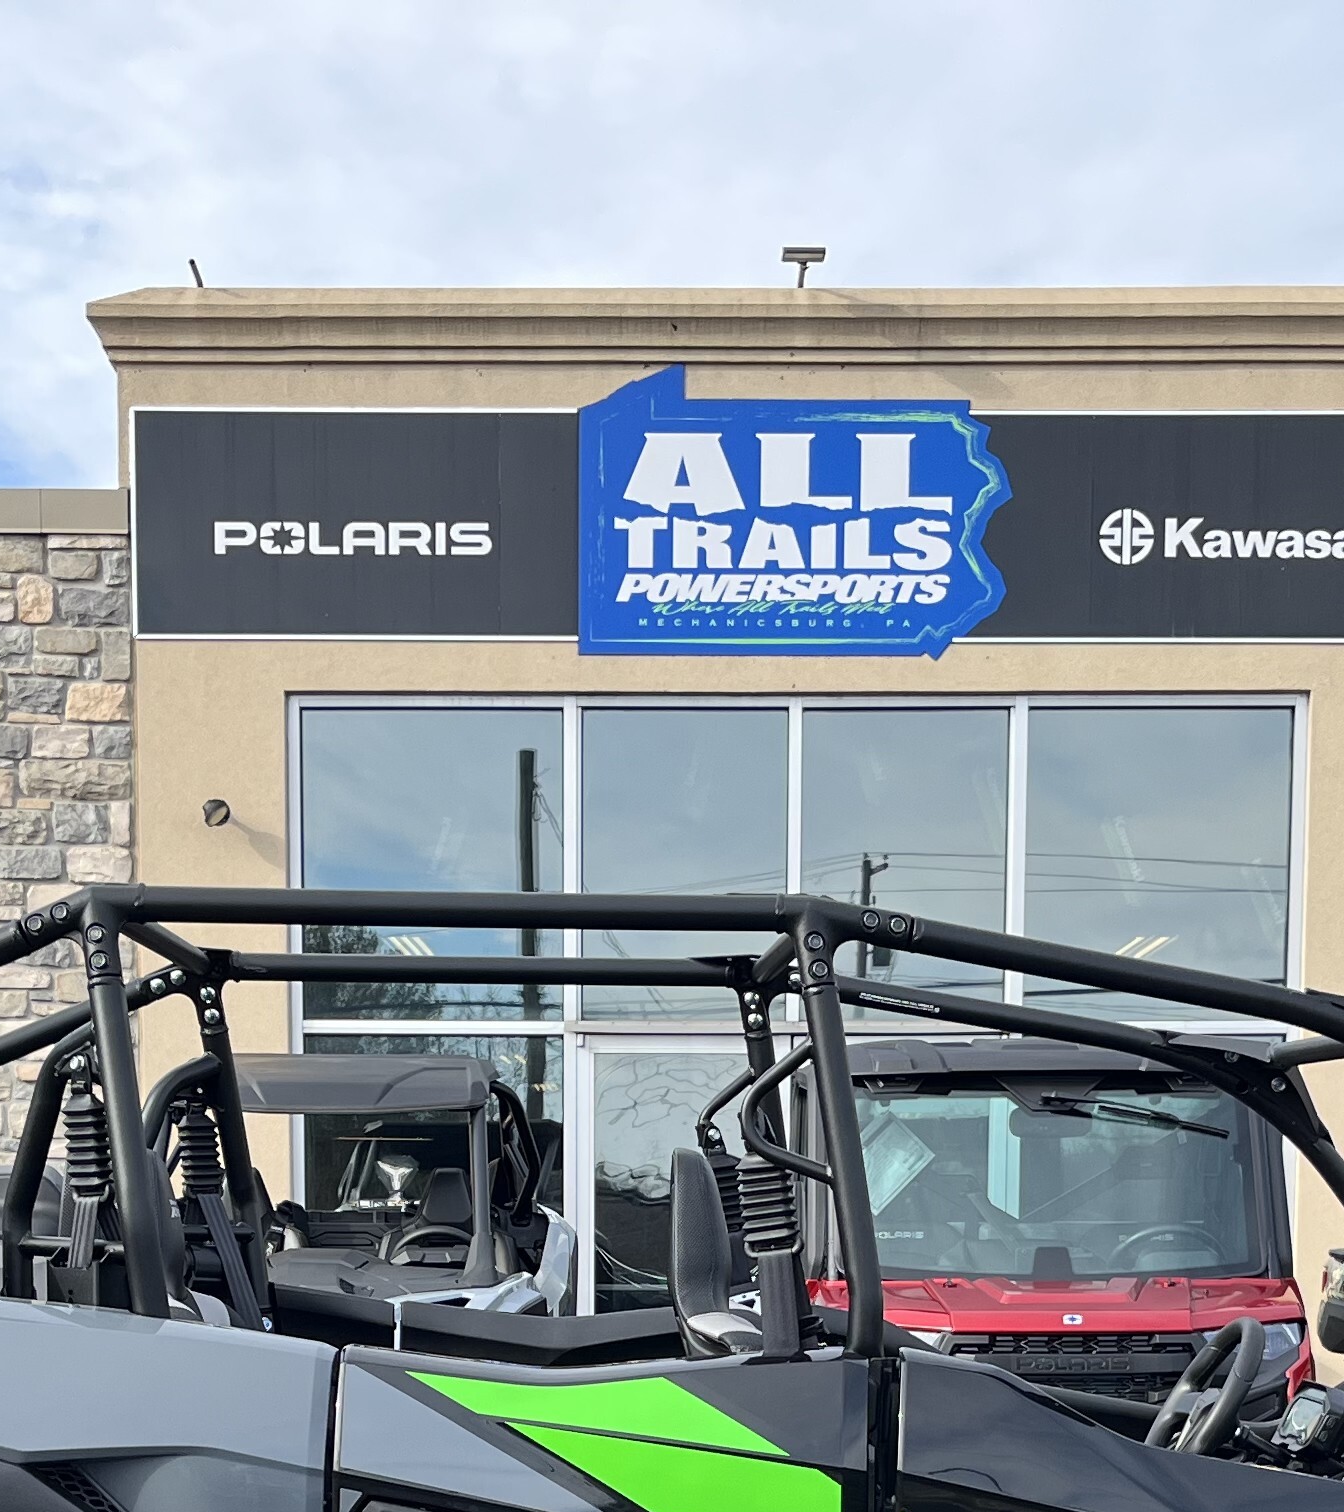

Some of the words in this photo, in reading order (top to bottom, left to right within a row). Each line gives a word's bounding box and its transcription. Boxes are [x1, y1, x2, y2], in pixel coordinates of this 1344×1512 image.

[623, 432, 953, 516] ALL
[214, 521, 493, 555] POLARIS
[613, 517, 952, 570] TRAILS
[615, 573, 950, 604] POWERSPORTS
[652, 600, 725, 616] Where
[727, 600, 773, 616] All
[777, 600, 839, 615] Trails
[886, 618, 911, 629] PA
[1016, 1357, 1131, 1372] POLARIS
